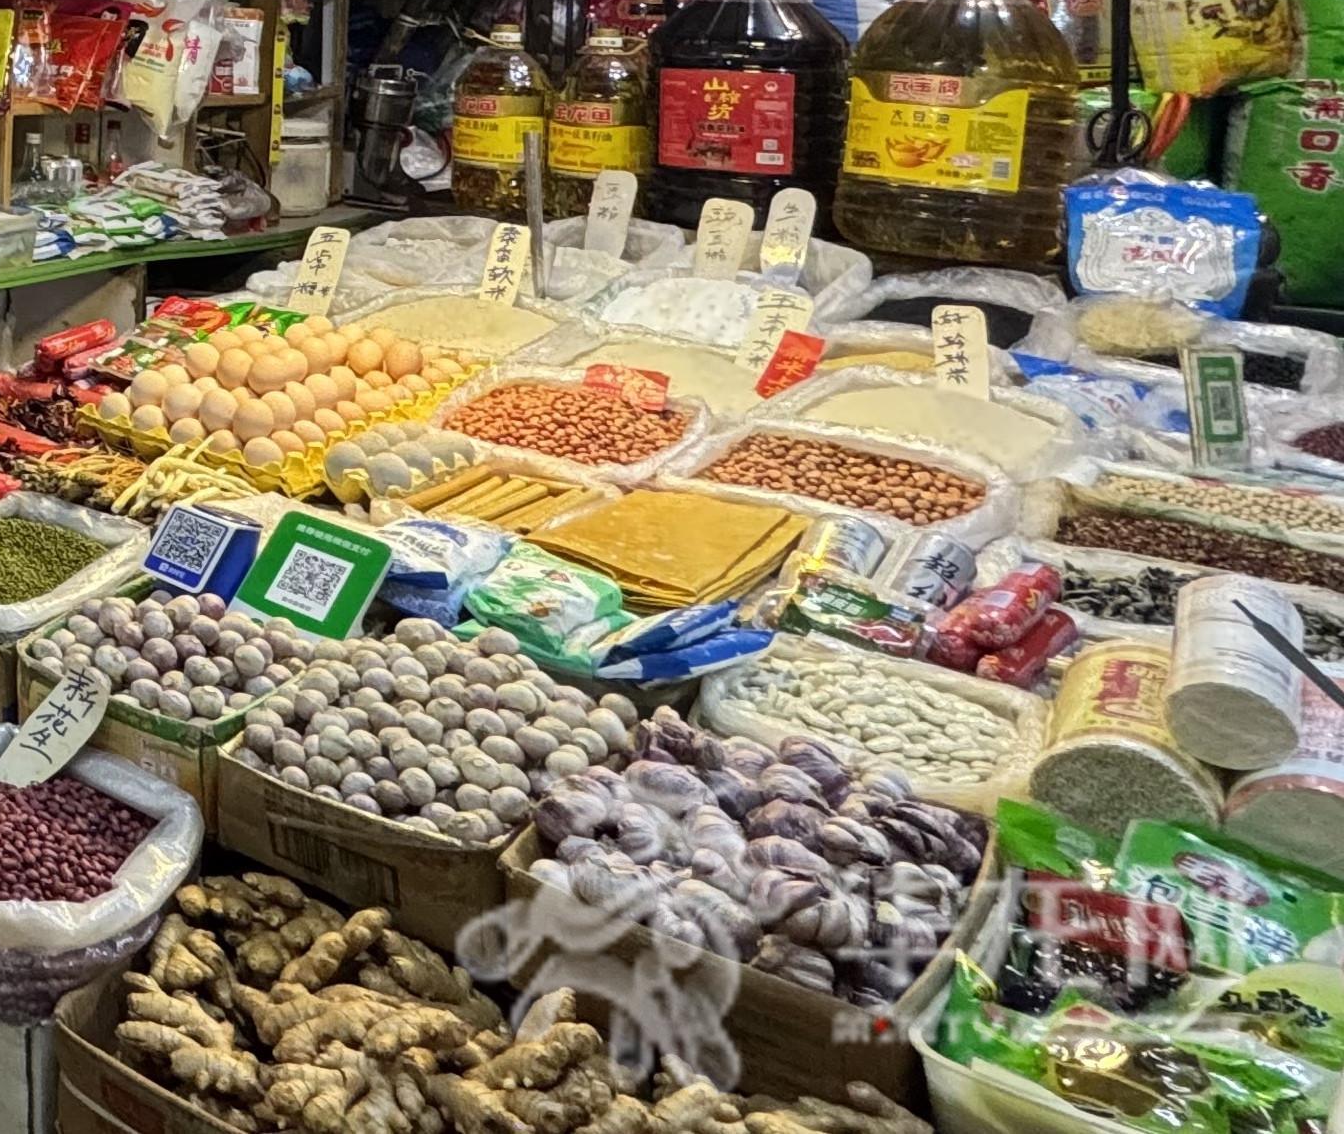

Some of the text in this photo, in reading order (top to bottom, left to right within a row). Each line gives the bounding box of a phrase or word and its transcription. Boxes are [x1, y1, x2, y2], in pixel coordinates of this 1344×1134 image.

[891, 75, 963, 100] 元宝牌
[554, 102, 614, 124] 金龙鱼
[18, 667, 107, 765] 新花生
